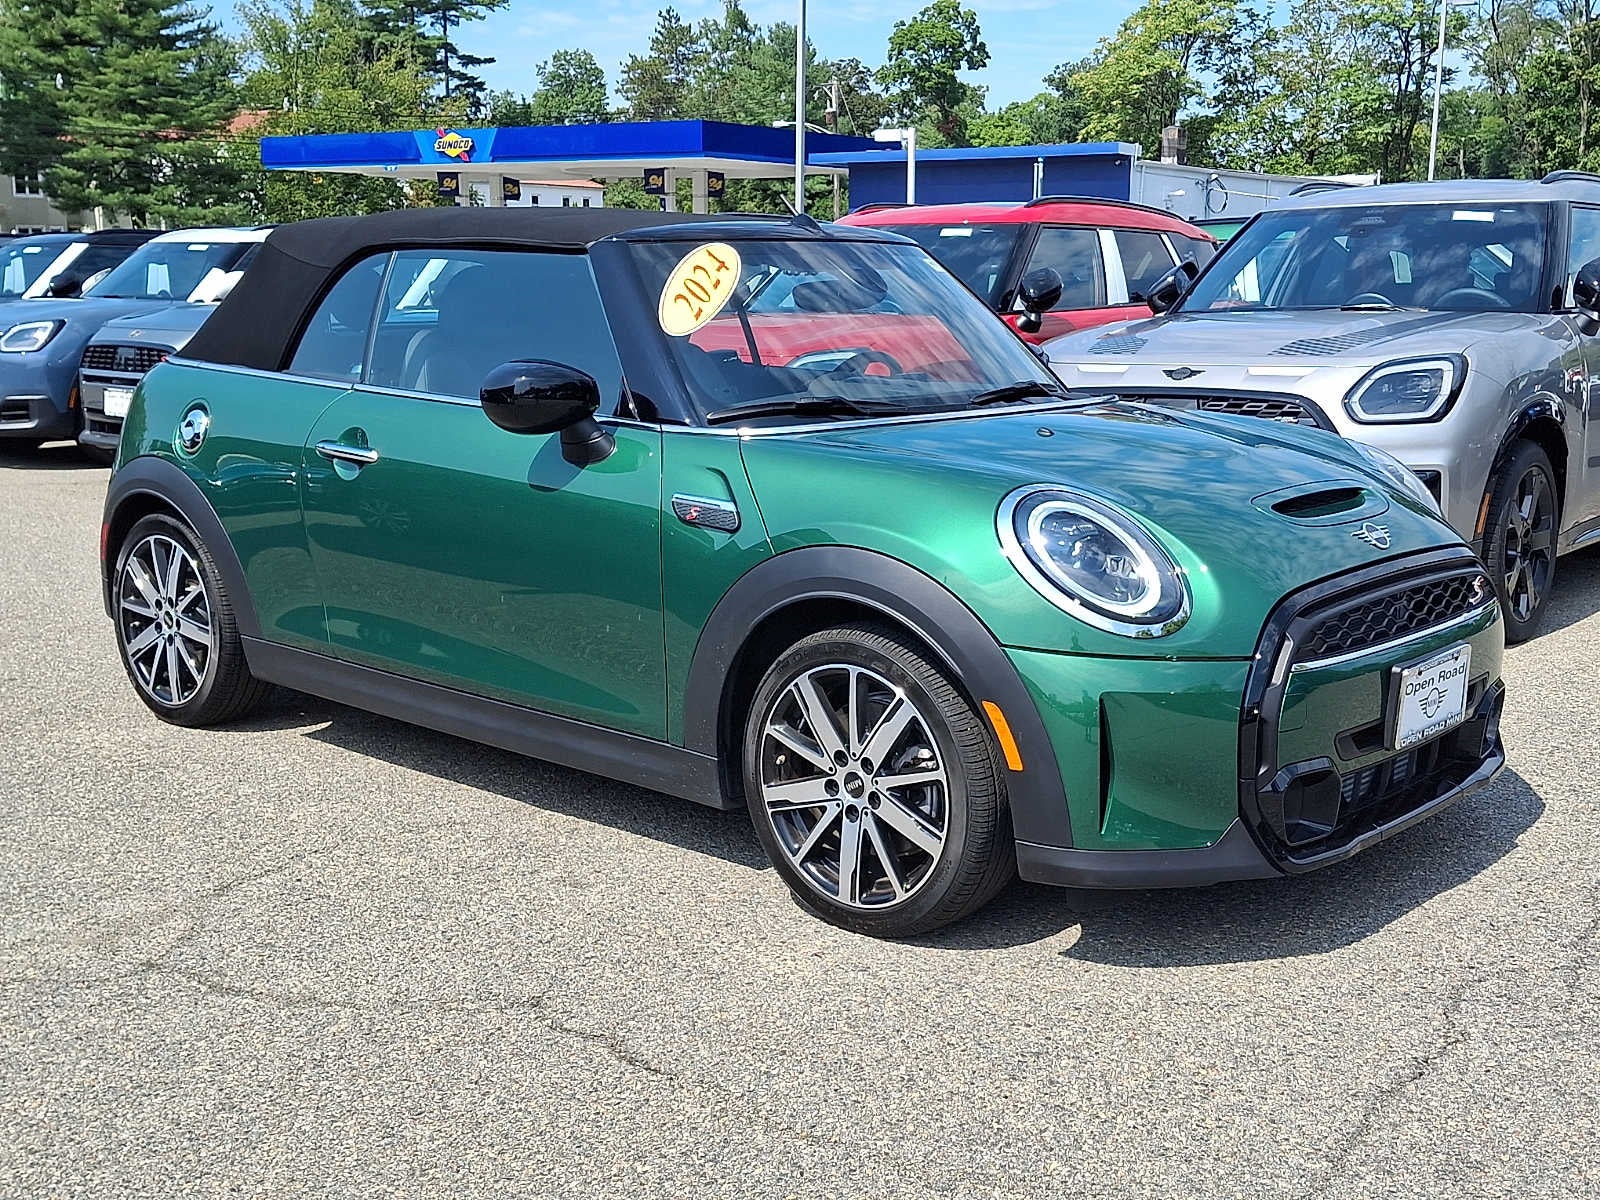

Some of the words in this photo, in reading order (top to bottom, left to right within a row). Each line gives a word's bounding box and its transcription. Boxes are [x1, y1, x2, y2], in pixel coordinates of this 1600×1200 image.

[436, 139, 471, 150] SUNOCO
[673, 248, 730, 322] 2024
[1405, 676, 1435, 696] Open
[1437, 662, 1466, 684] Road
[1400, 730, 1424, 747] OPEN
[1424, 721, 1446, 736] ROAD
[1446, 713, 1463, 728] MINI
